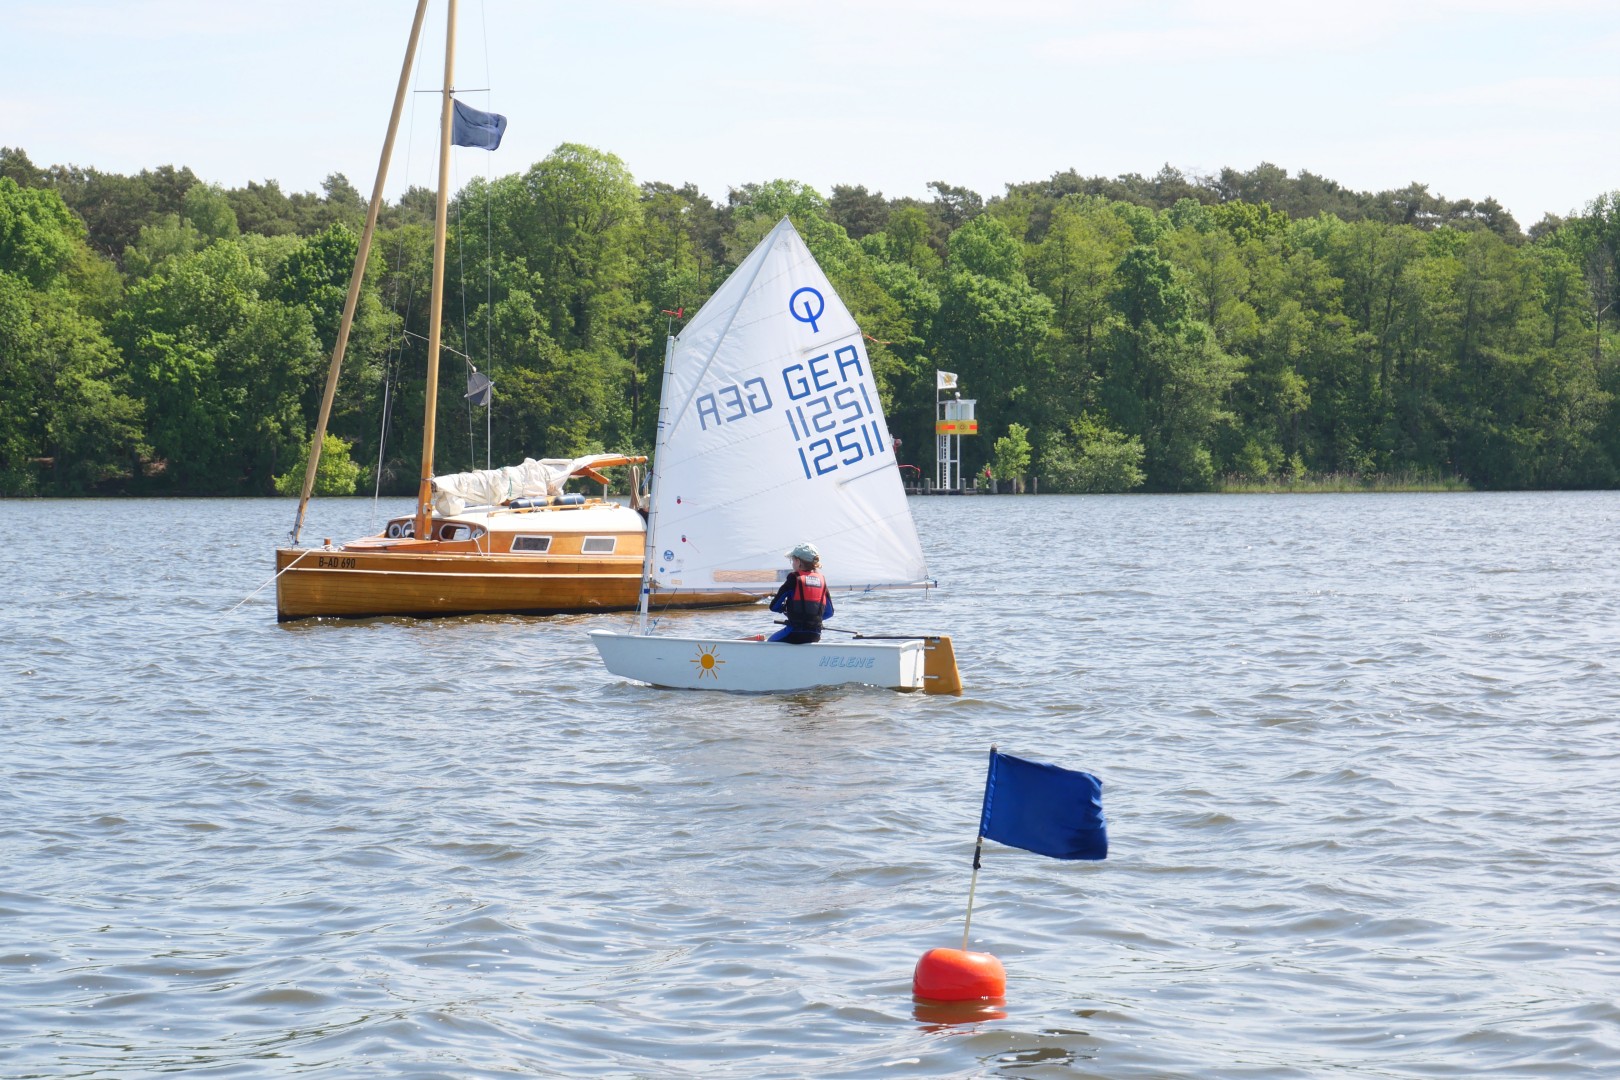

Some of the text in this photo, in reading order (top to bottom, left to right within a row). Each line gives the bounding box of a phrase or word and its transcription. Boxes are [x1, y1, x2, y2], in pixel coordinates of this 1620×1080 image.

[782, 344, 863, 401] GER
[797, 420, 885, 480] 12511
[319, 556, 356, 569] B-AD 690
[819, 656, 875, 668] HELENE
